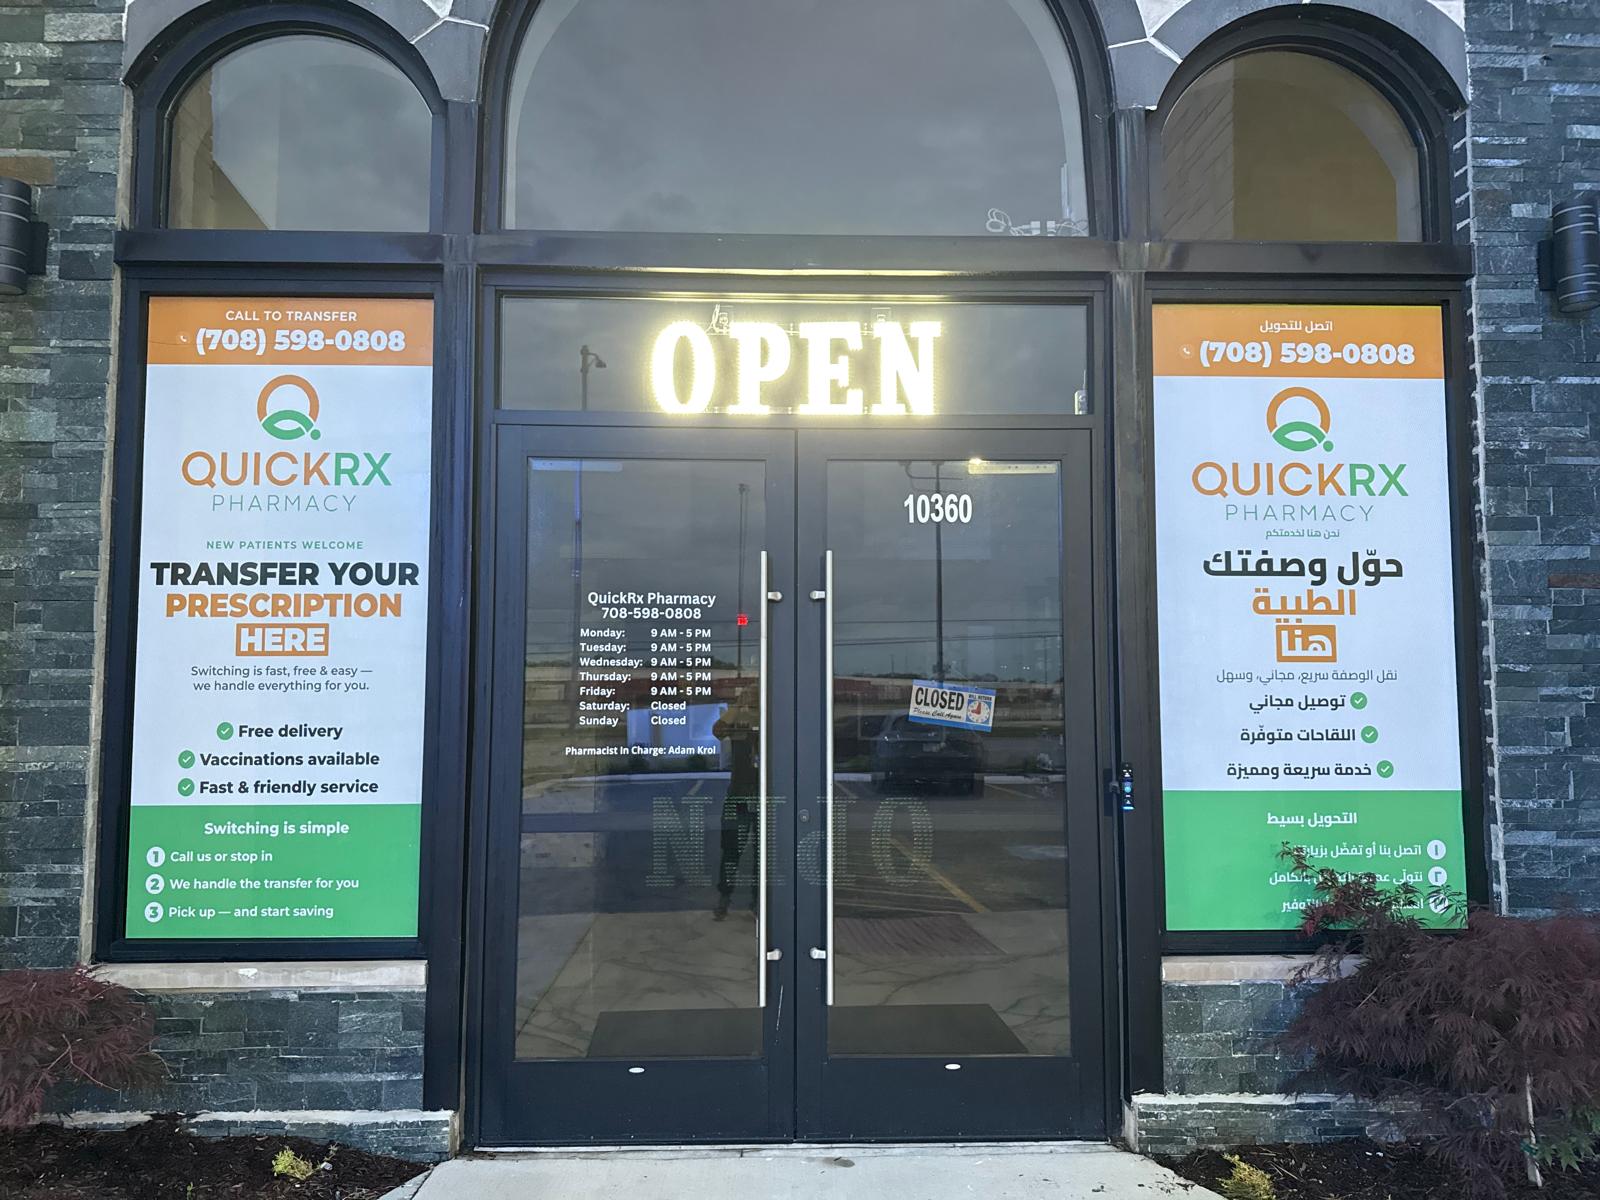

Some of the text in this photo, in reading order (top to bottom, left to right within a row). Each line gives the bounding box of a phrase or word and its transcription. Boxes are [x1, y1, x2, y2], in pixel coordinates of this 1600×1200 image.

[226, 310, 357, 321] CALL TO TRANSFER
[1260, 320, 1333, 333] اتصل للتحويل
[196, 328, 405, 355] (708) 598-0808
[1200, 340, 1415, 368] (708) 598-0808
[651, 319, 942, 416] OPEN
[181, 451, 392, 488] QUICKRX
[1192, 461, 1409, 498] QUICKRX
[212, 494, 356, 512] PHARMACY
[903, 493, 973, 524] 10360
[1226, 504, 1374, 522] PHARMACY
[1265, 529, 1340, 540] نحن هنا لخدمتكم
[206, 541, 363, 550] NEW PATIENTS WELCOME
[150, 562, 419, 586] TRANSFER YOUR
[1203, 550, 1327, 586] وصفتك
[166, 593, 402, 618] PRESCRIPTION
[588, 591, 716, 608] QuickRx Pharmacy
[1252, 588, 1356, 623] الطبية
[601, 607, 701, 619] 708-598-0808
[240, 628, 325, 651] HERE
[580, 628, 625, 640] Monday:
[651, 628, 658, 637] 9
[660, 628, 677, 637] AM
[686, 629, 692, 638] 5
[695, 629, 711, 638] PM
[579, 642, 626, 654] Tuesday:
[651, 643, 658, 652] 9
[660, 643, 677, 652] AM
[686, 643, 692, 652] 5
[695, 643, 711, 652] PM
[1281, 629, 1332, 656] هنا
[579, 657, 643, 669] Wednesday:
[650, 657, 658, 666] 9
[660, 657, 677, 666] AM
[686, 657, 692, 667] 5
[695, 657, 711, 666] PM
[191, 665, 250, 678] Switching
[253, 665, 263, 676] is
[265, 665, 290, 677] fast,
[293, 665, 317, 676] free
[319, 666, 328, 676] &
[331, 668, 358, 678] easy
[579, 671, 631, 683] Thursday:
[651, 672, 658, 681] 9
[660, 672, 677, 681] AM
[686, 672, 693, 681] 5
[695, 672, 711, 681] PM
[1216, 669, 1253, 683] وسهل
[1331, 669, 1373, 683] الوصفة
[1376, 669, 1397, 684] نقل
[193, 680, 369, 693] we handle everything for you.
[580, 686, 616, 698] Friday:
[651, 686, 658, 696] 9
[659, 687, 677, 695] AM
[686, 686, 693, 696] 5
[695, 687, 711, 696] PM
[579, 701, 686, 712] Saturday: Closed
[915, 687, 965, 711] CLOSED
[1249, 694, 1346, 714] توصيل مجاني
[931, 709, 945, 717] Call
[579, 715, 686, 727] Sunday Closed
[239, 723, 343, 740] Free delivery
[1297, 728, 1355, 741] اللقاحات
[200, 751, 380, 766] Vaccinations available
[565, 745, 716, 757] Pharmacist In Charge: Adam Krol
[1227, 763, 1371, 780] خدمة سريعة ومميزة
[200, 779, 379, 796] Fast & friendly service
[1267, 812, 1357, 828] التحويل بسيط
[204, 821, 349, 837] Switching is simple
[1331, 842, 1363, 858] تفضّل
[1365, 841, 1376, 857] أو
[1380, 845, 1391, 858] بنا
[1394, 845, 1422, 858] اتصل
[153, 850, 273, 864] 1 Call us or stop in
[150, 877, 359, 891] 2 We handle the transfer for you
[149, 906, 159, 918] 3
[169, 906, 196, 917] Pick
[199, 909, 216, 920] up
[234, 906, 258, 917] and
[261, 906, 290, 917] start
[293, 905, 334, 919] saving
